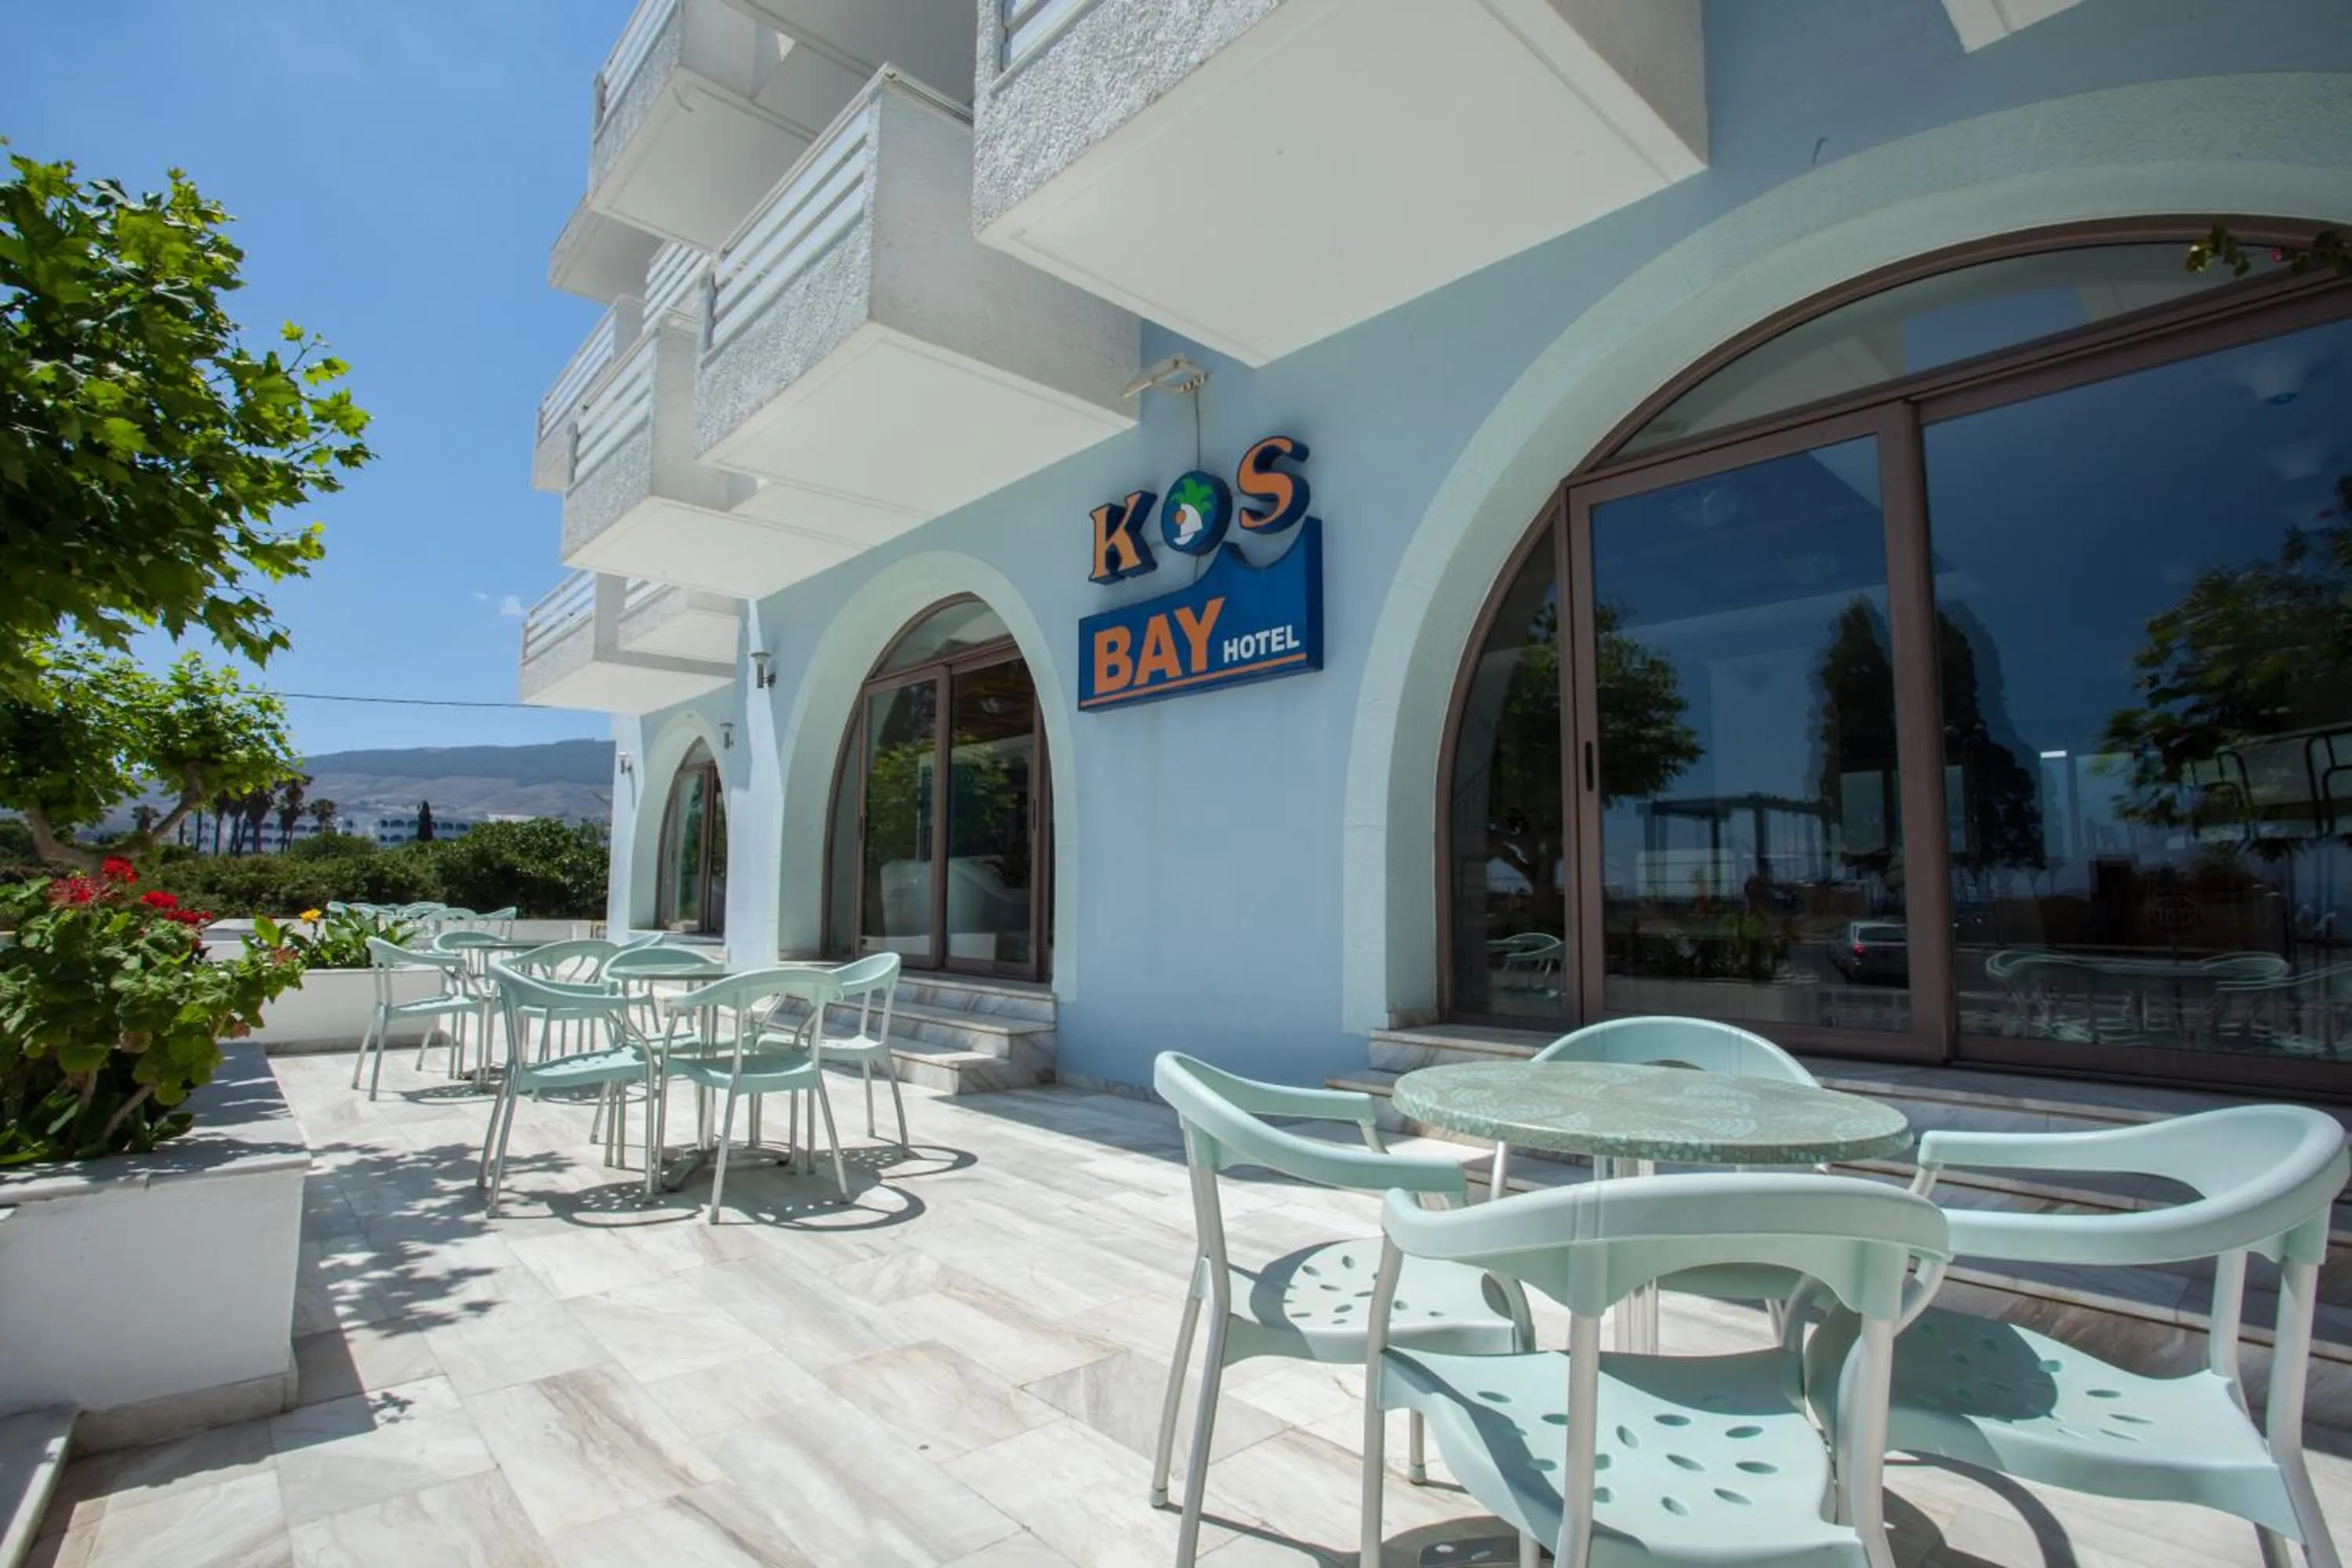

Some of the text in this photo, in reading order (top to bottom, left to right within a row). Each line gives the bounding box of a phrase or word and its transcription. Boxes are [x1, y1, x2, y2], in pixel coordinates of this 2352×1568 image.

[1088, 436, 1310, 585] KOS
[1094, 597, 1300, 694] BAY HOTEL
